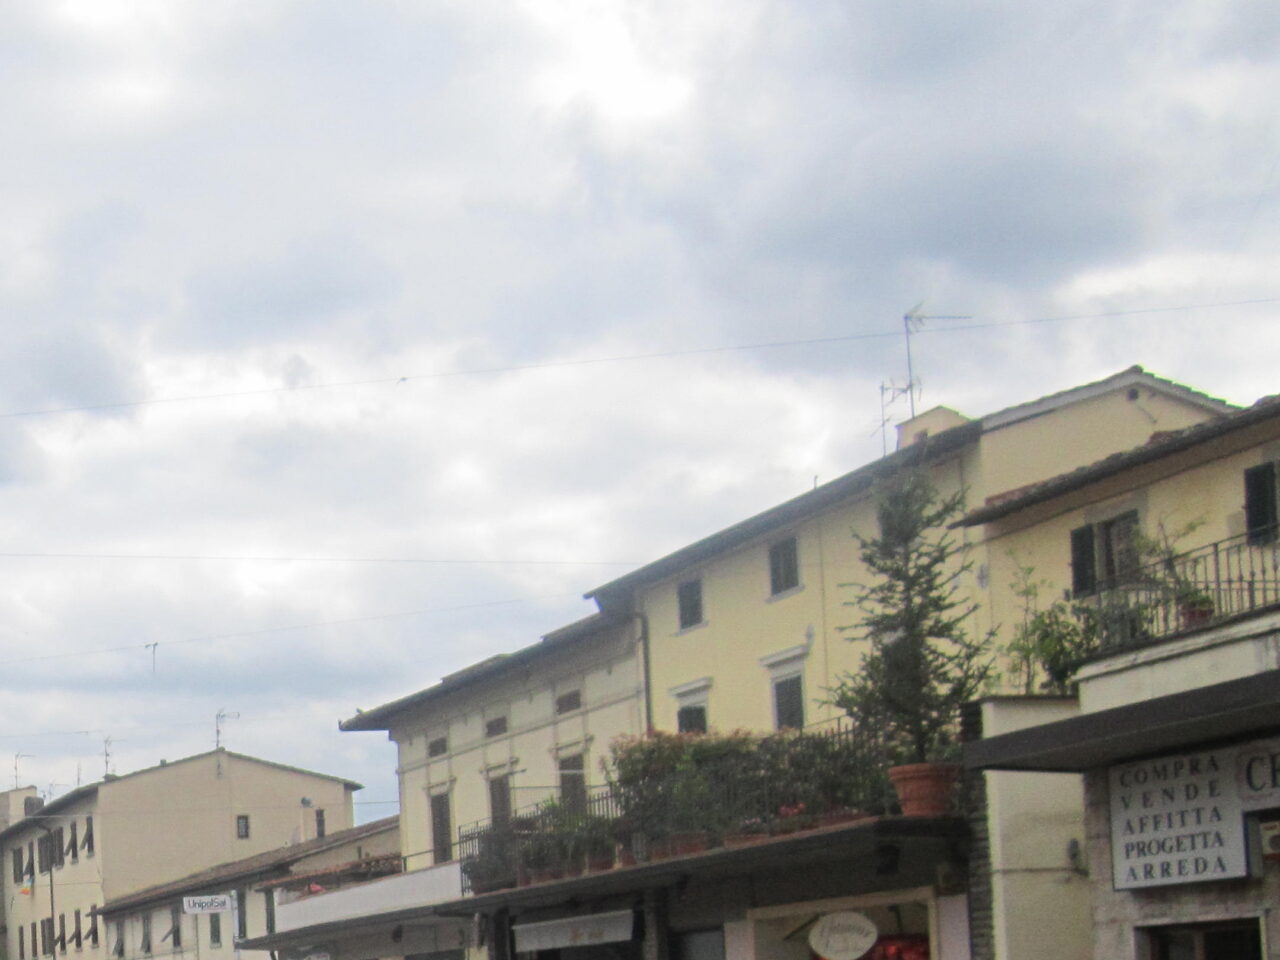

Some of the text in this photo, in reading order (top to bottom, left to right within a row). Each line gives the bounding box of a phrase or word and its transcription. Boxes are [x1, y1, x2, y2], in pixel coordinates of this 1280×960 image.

[1120, 754, 1220, 788] COMPRA
[1121, 780, 1221, 811] VENDE
[1122, 805, 1223, 836] AFFITTA
[1124, 830, 1225, 860] PROGETTA
[1125, 855, 1228, 883] ARREDA
